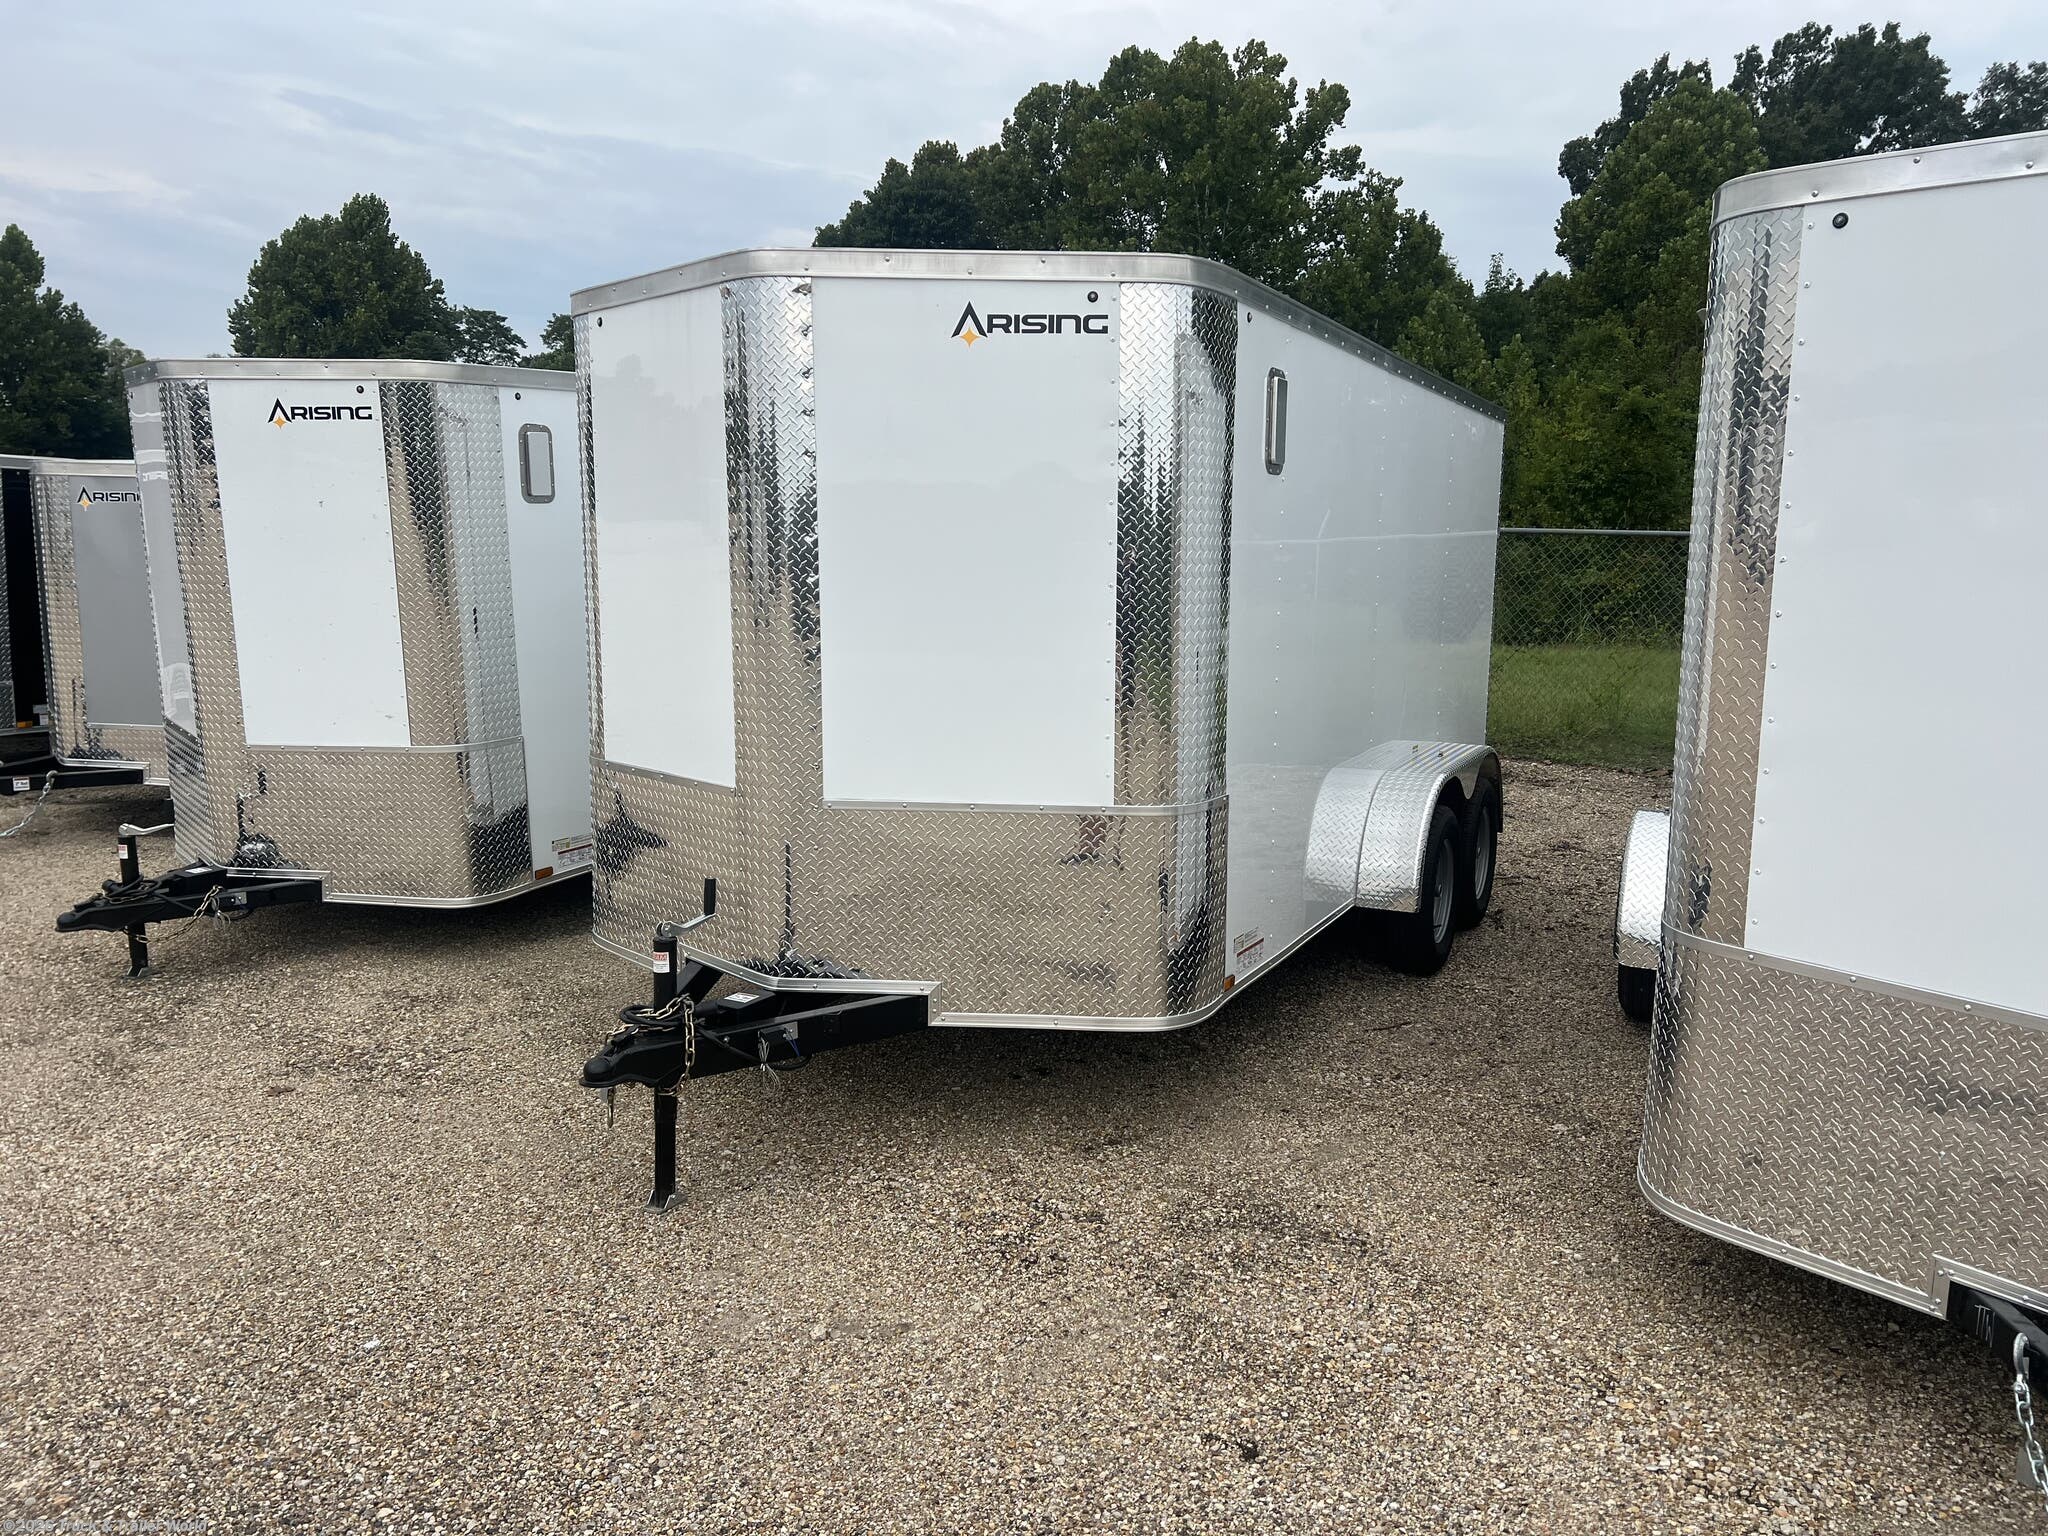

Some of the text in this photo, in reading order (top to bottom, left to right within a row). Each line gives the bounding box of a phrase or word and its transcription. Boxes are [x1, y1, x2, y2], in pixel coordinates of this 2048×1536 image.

[951, 301, 1108, 338] ARISING
[268, 398, 372, 423] ARISING
[77, 486, 140, 503] ARISIN
